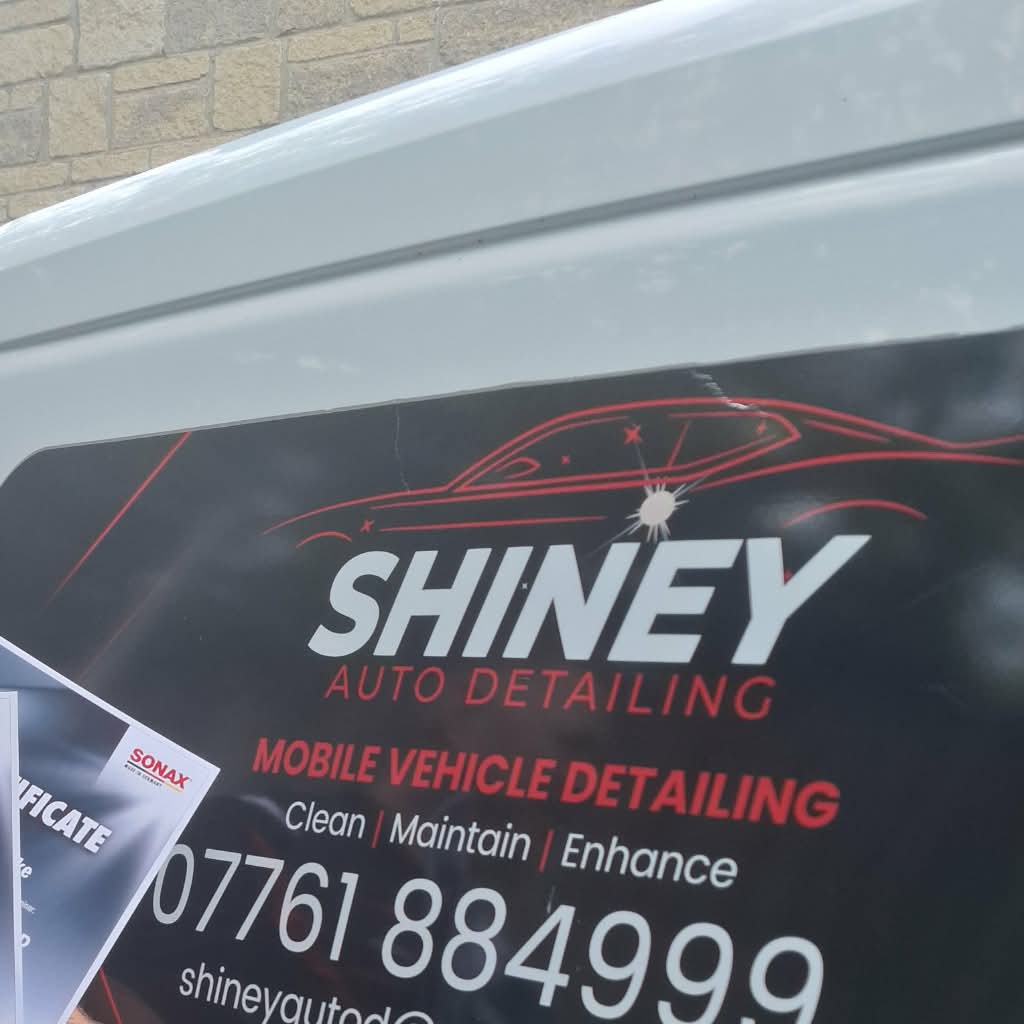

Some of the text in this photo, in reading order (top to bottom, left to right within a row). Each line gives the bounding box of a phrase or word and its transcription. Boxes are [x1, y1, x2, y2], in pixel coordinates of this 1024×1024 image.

[307, 534, 872, 665] SHINEY
[324, 664, 777, 721] AUTO DETAILING
[129, 748, 190, 790] SONAX
[251, 737, 841, 829] MOBILE VEHICLE DETAILING
[18, 775, 113, 854] IFICATE
[285, 801, 739, 889] Clean Maintain Enhance
[152, 843, 360, 962] 07761
